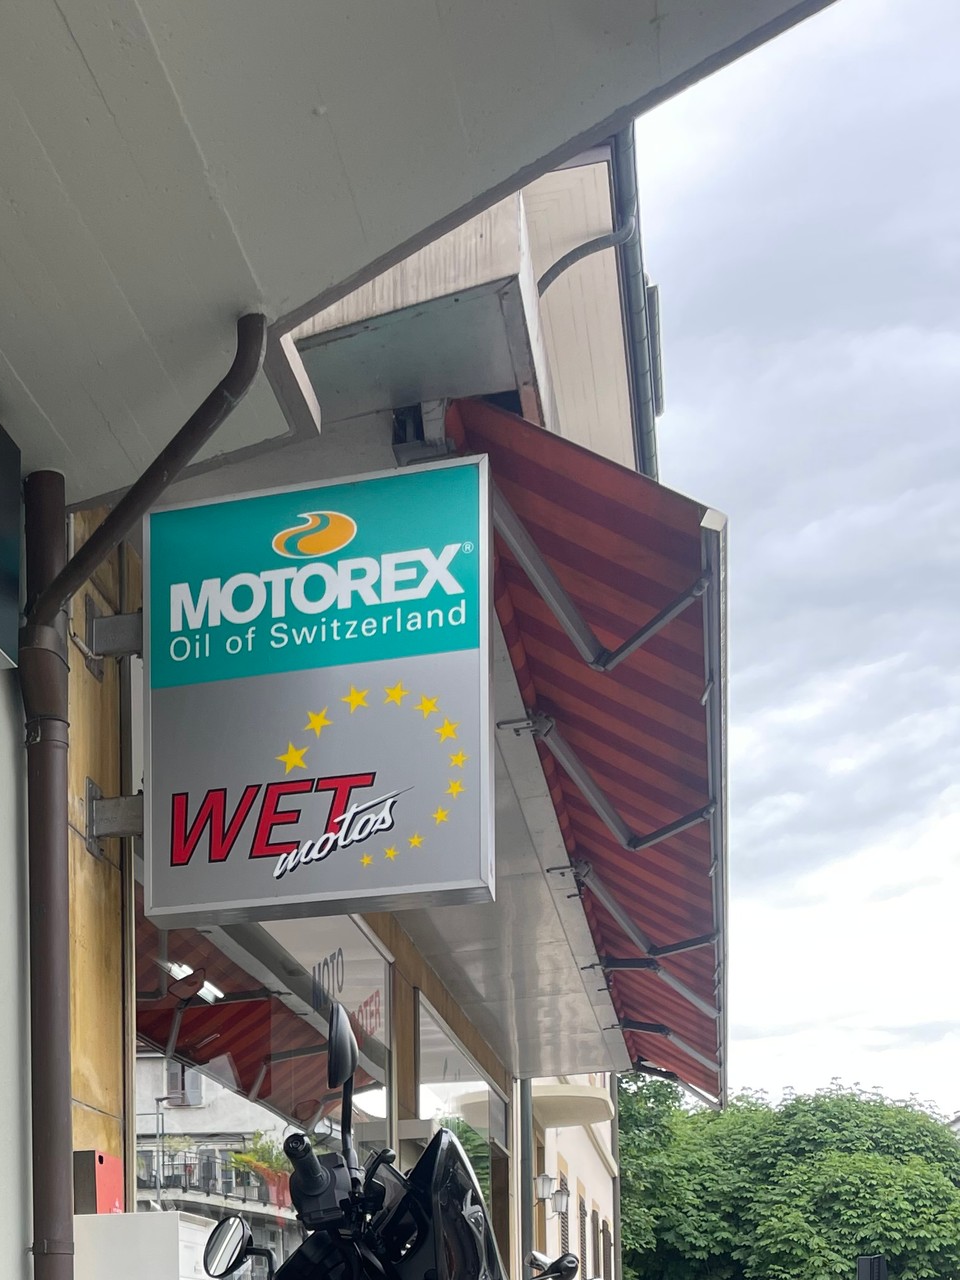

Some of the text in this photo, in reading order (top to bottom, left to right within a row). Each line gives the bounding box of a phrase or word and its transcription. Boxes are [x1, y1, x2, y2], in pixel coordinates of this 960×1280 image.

[169, 599, 466, 662] Oil of Switzerland
[170, 771, 377, 867] WET
[272, 786, 414, 879] motos
[312, 947, 344, 1012] MOTO
